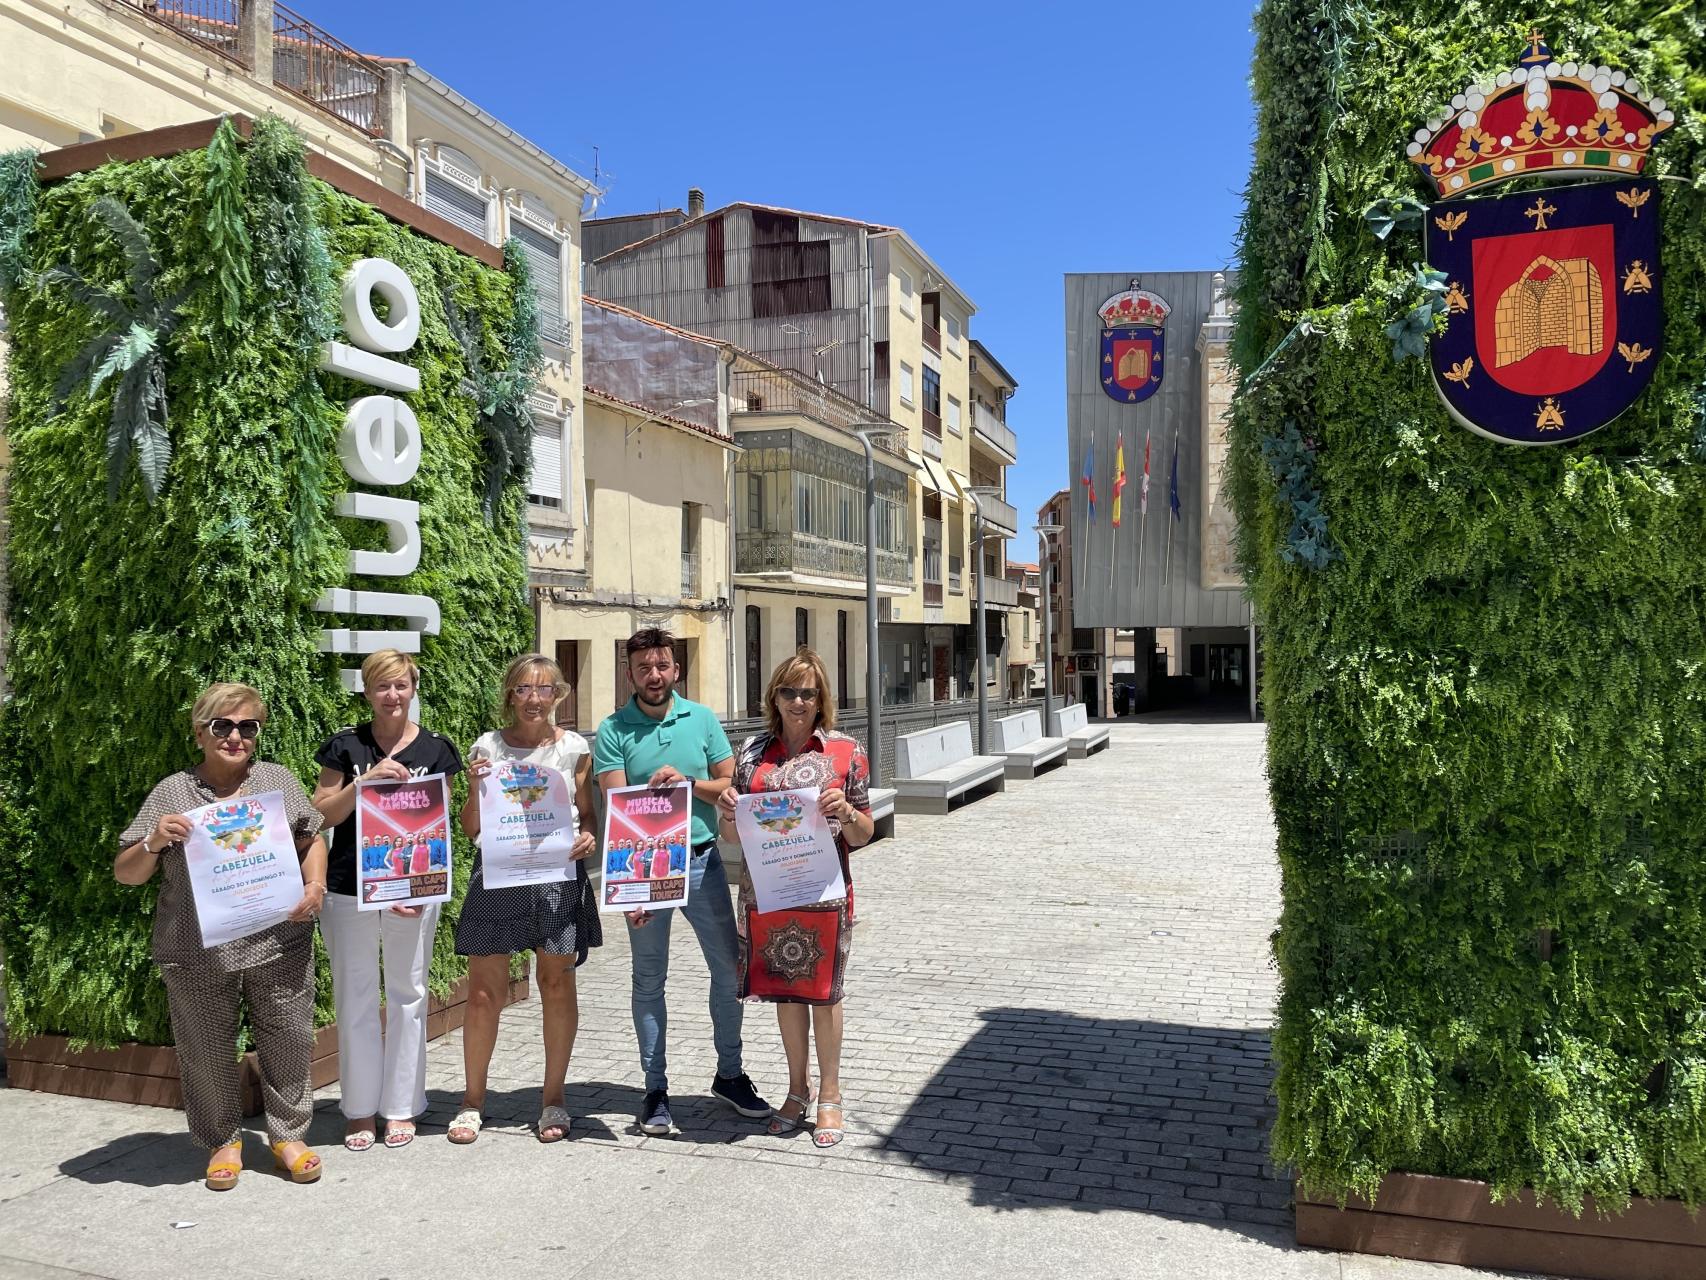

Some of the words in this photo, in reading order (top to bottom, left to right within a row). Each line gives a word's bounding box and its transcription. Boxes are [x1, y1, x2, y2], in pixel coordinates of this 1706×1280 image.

[626, 795, 671, 807] MUSICAL
[499, 812, 555, 824] CABEZUELA
[761, 835, 815, 850] CABEZUELA
[212, 852, 276, 874] CABEZUELA
[250, 873, 278, 885] DOMINGO
[410, 877, 423, 886] DA
[423, 874, 446, 885] CAPO
[651, 881, 662, 890] DA
[663, 879, 684, 889] CAPO
